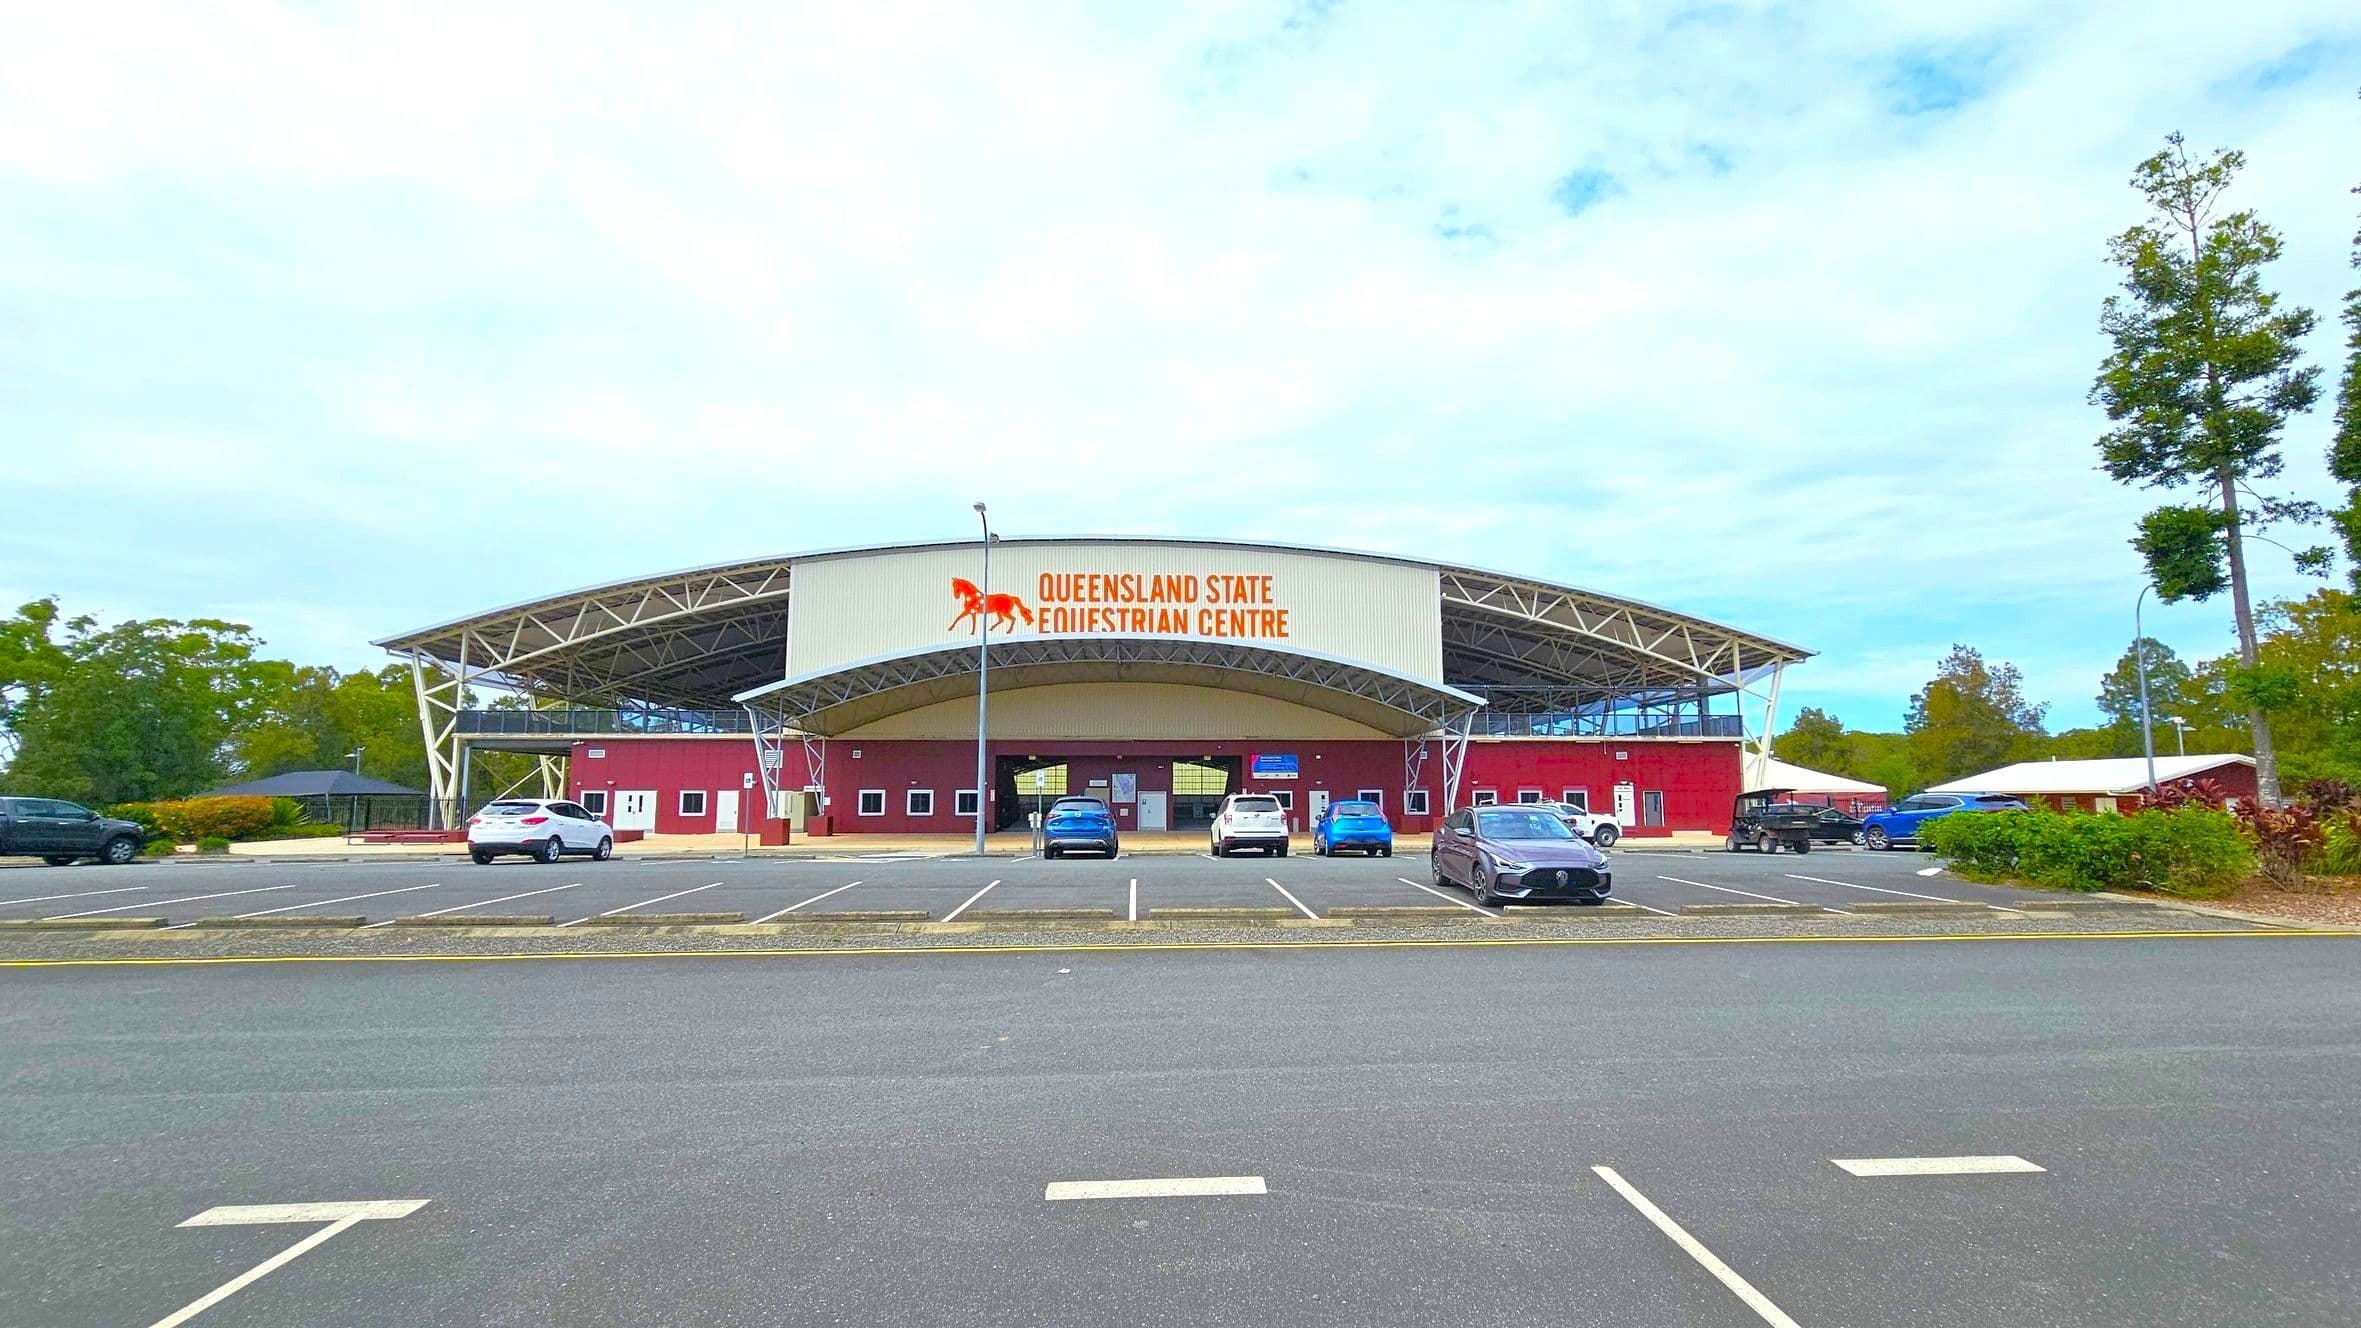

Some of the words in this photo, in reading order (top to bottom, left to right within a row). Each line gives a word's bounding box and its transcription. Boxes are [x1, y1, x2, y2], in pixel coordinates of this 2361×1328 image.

[1039, 573, 1198, 603] QUEENSLAND
[1206, 575, 1273, 603] STATE
[1039, 607, 1188, 634] EQUESTRIAN
[1198, 609, 1289, 637] CENTRE
